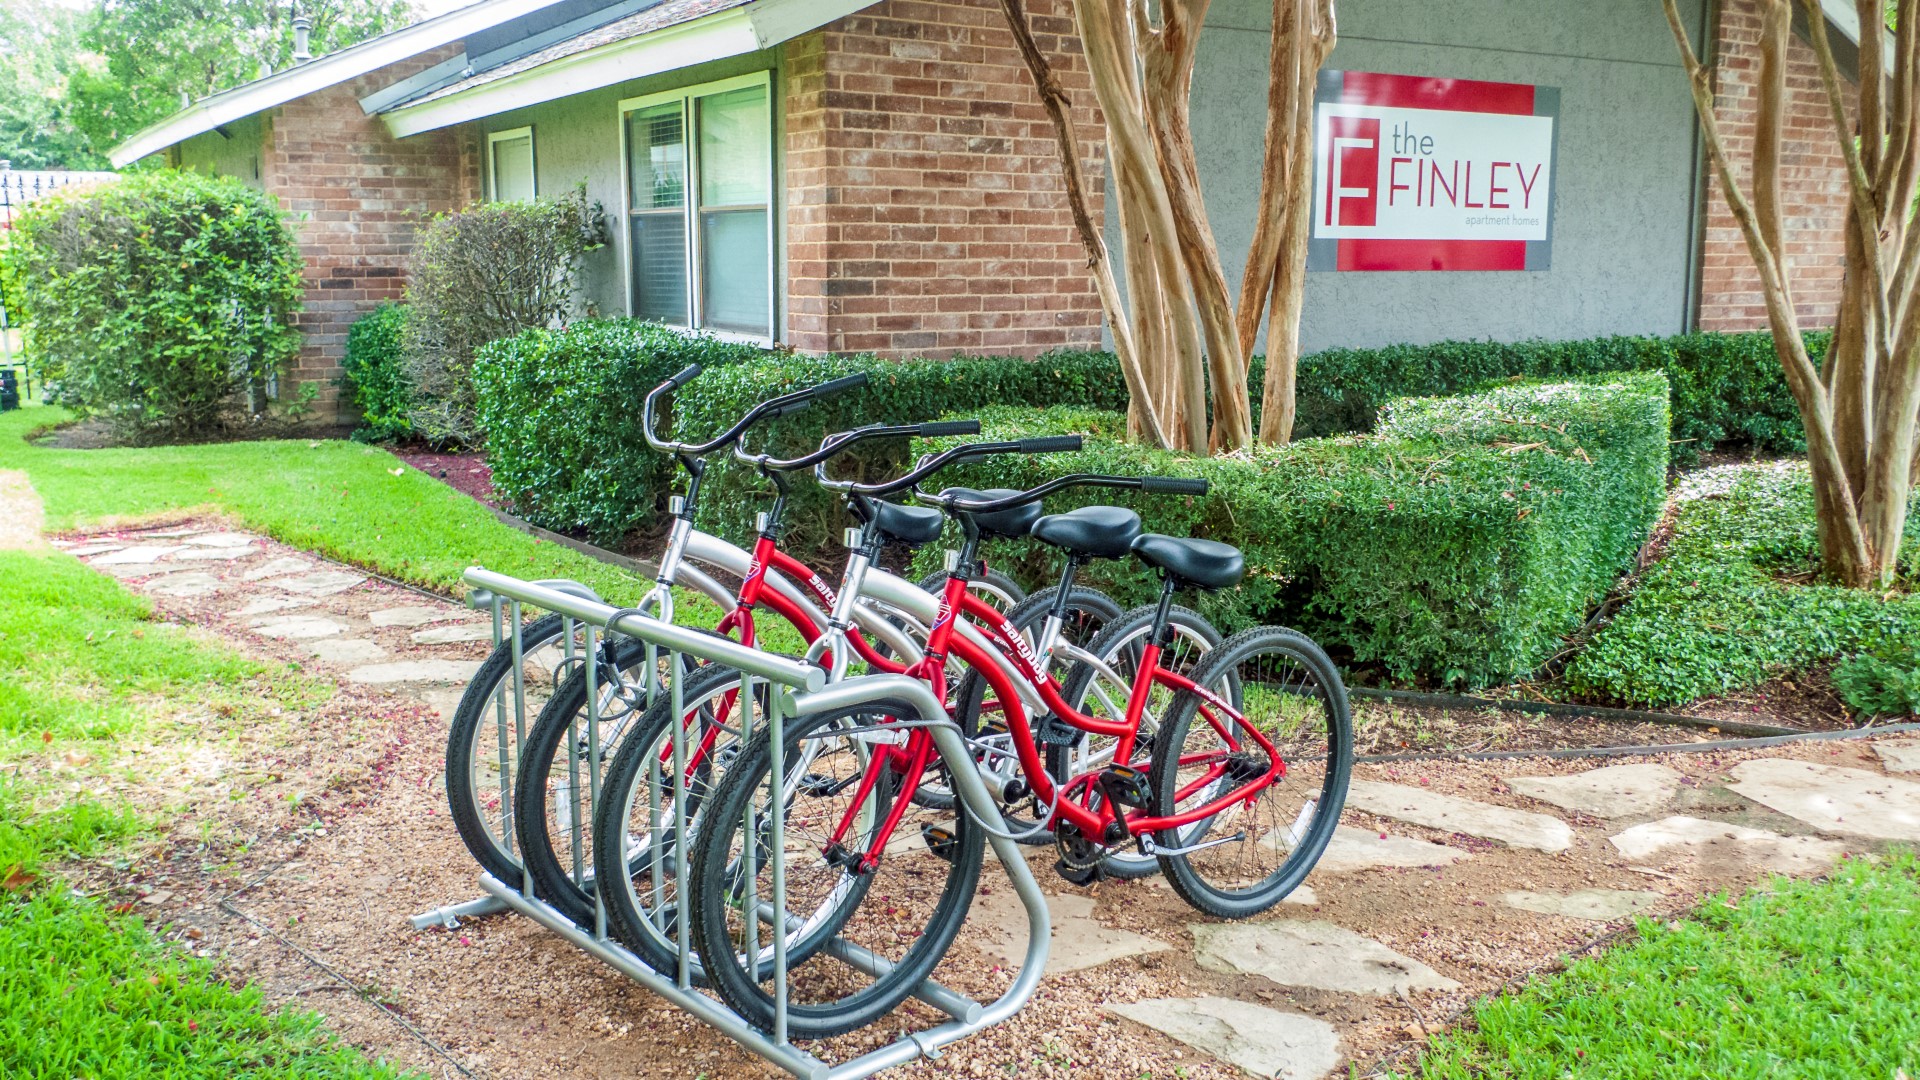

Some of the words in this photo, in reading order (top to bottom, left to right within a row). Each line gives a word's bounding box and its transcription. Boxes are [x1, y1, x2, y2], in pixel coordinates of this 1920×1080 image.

[1392, 121, 1434, 155] the
[1389, 157, 1542, 209] FINLEY
[1465, 214, 1510, 228] apartment
[1512, 213, 1540, 226] homes
